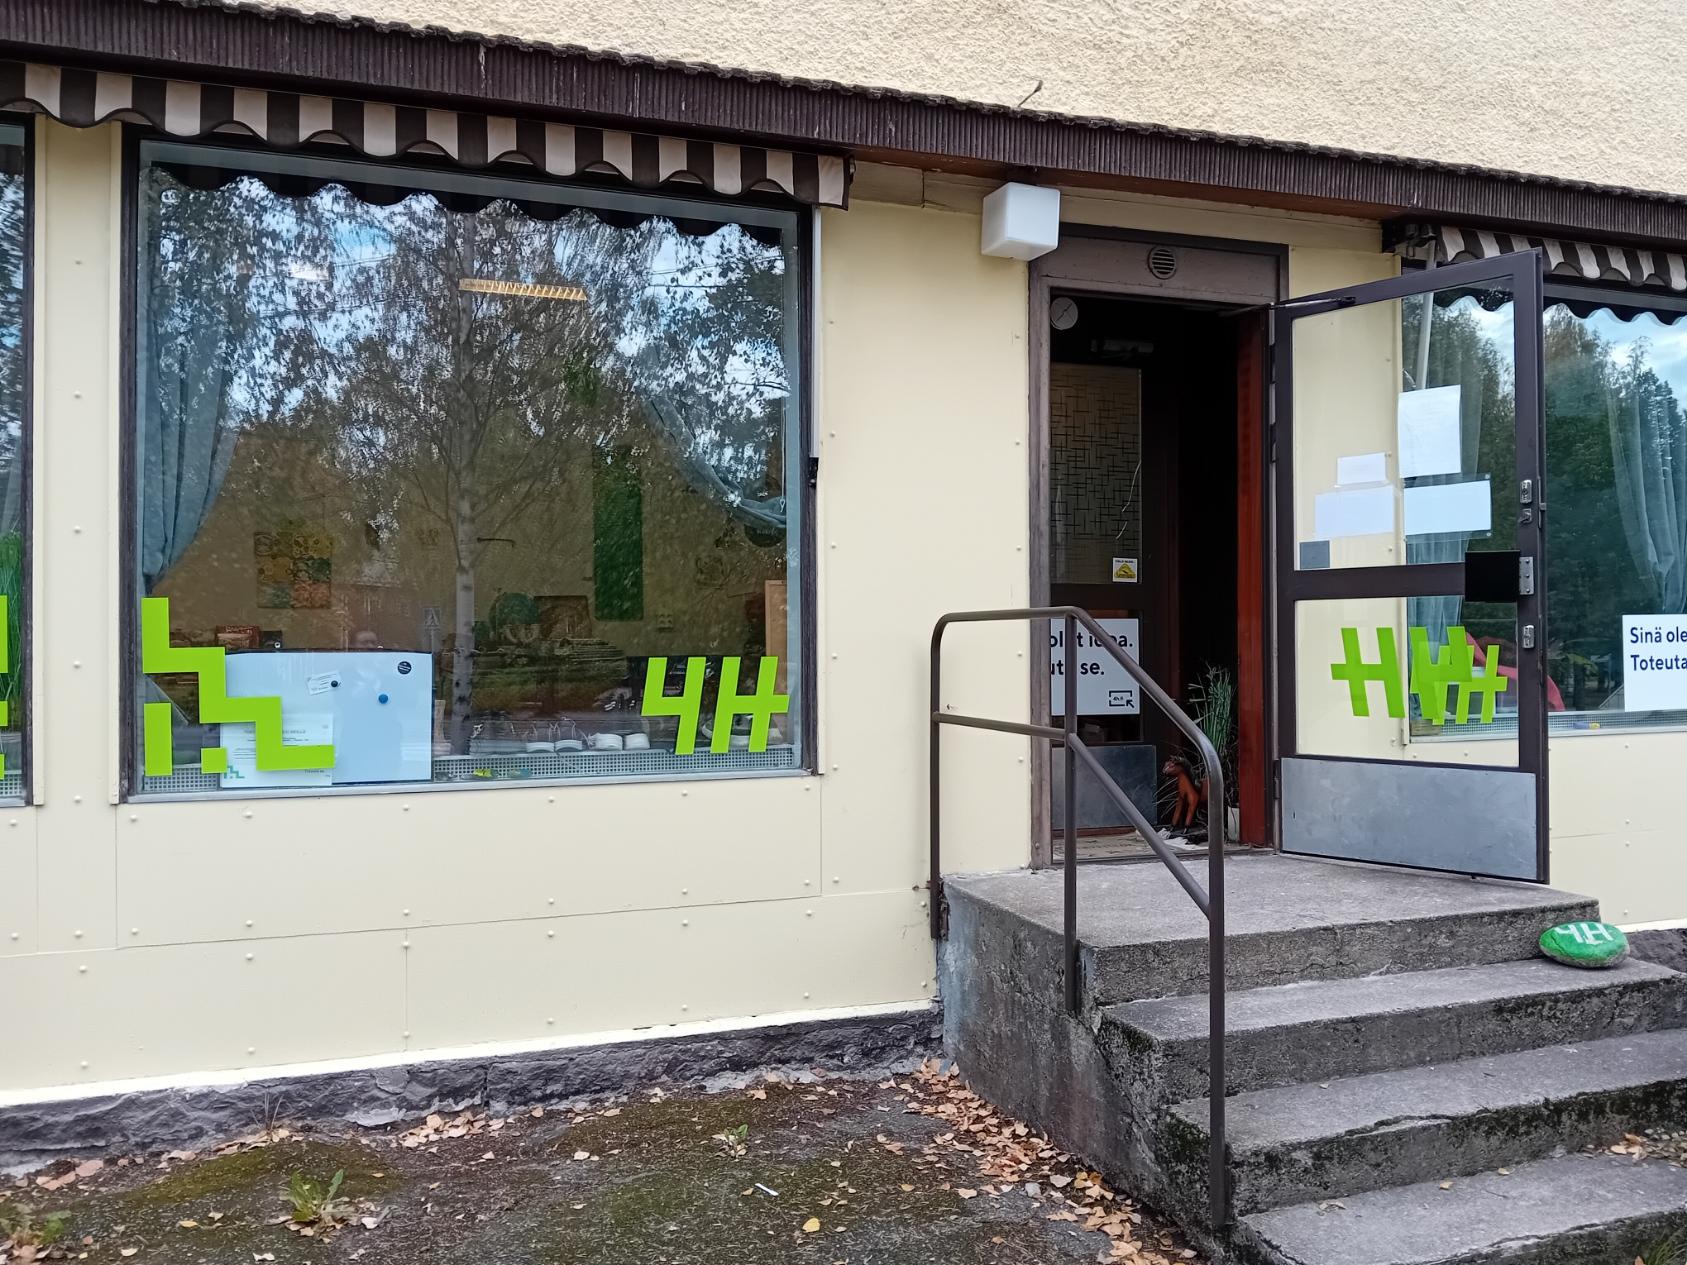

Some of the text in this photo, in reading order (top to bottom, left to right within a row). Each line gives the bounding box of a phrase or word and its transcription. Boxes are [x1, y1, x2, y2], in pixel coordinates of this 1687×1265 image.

[1050, 631, 1083, 647] olt
[1630, 626, 1662, 644] Sinä
[1080, 661, 1104, 676] se.
[1630, 654, 1687, 671] Toteuta
[641, 656, 790, 754] 4H
[1554, 922, 1614, 945] 4H
